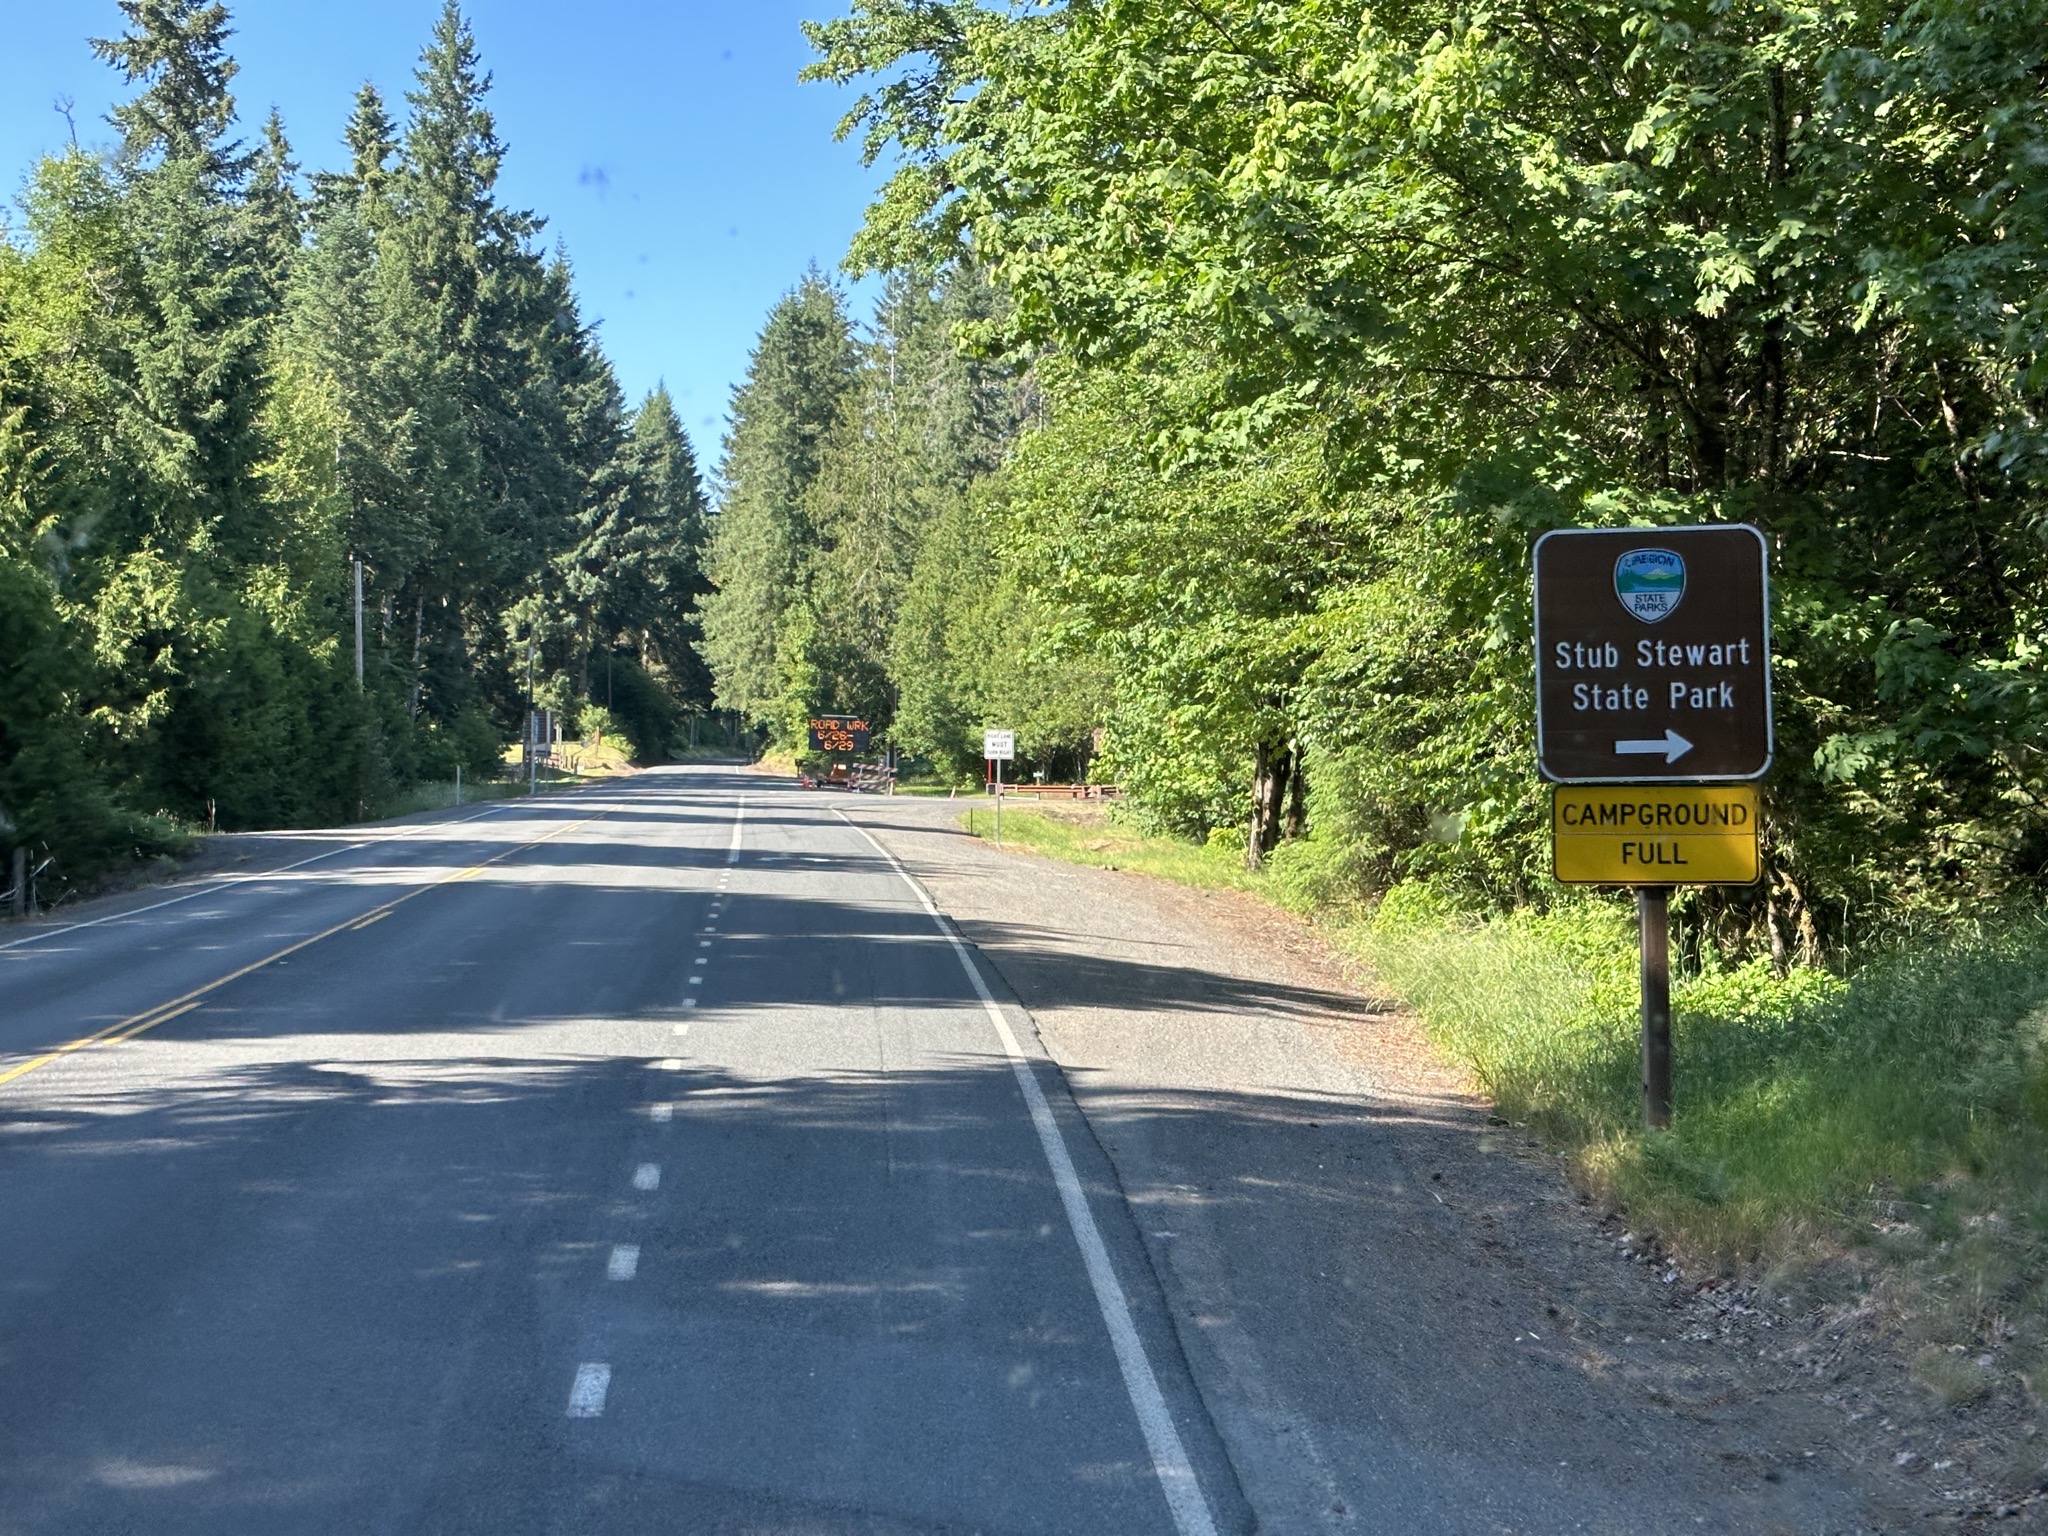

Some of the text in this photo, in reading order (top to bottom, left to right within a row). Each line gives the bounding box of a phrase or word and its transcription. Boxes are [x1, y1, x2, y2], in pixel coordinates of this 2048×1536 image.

[1635, 593, 1666, 603] STATE
[1635, 603, 1668, 612] PARKS
[1555, 637, 1750, 669] Stub Stewart
[1573, 681, 1734, 711] State Park
[810, 719, 869, 731] ROAD WRK
[824, 740, 854, 751] 6/29
[1562, 803, 1748, 826] CAMPGROUND
[1622, 842, 1688, 865] FULL
